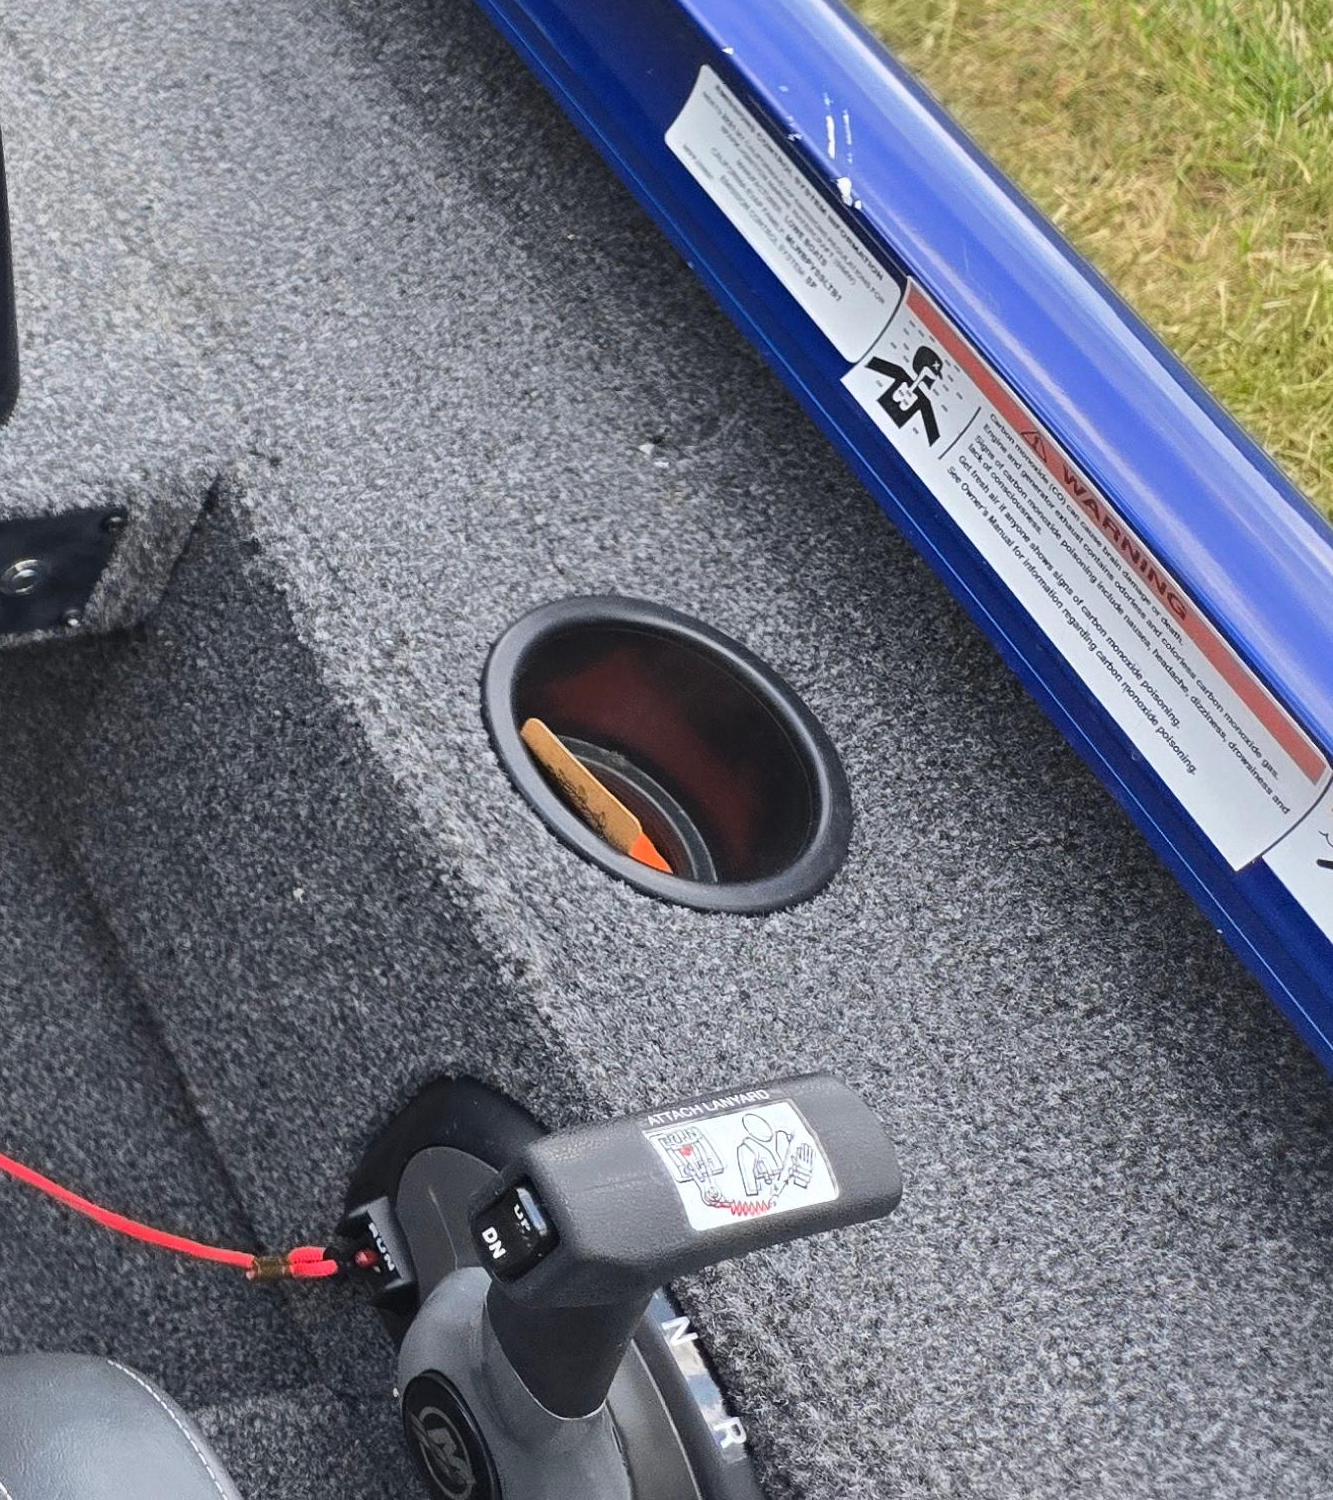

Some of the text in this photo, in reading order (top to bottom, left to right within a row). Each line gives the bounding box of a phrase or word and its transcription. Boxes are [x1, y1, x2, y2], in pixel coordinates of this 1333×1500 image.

[967, 443, 1042, 535] lack of consciousness.
[990, 413, 1015, 445] Carbon
[1048, 483, 1067, 505] (CO)
[1066, 504, 1080, 522] can
[1080, 521, 1102, 548] cause
[1101, 546, 1122, 571] brain
[1122, 570, 1152, 605] damage
[1151, 605, 1161, 617] or
[1160, 616, 1183, 646] death.
[1062, 464, 1187, 621] WARNING
[947, 466, 962, 484] See
[987, 515, 1015, 547] Manual
[1012, 545, 1026, 560] for
[1022, 558, 1064, 609] information
[1061, 608, 1098, 652] regarding
[1095, 650, 1123, 683] carbon
[1121, 681, 1159, 726] monoxide
[1155, 726, 1197, 775] poisoning.
[958, 455, 1181, 729] Get fresh air if anyone shows signs of carbon monoxide poisoning.
[975, 435, 1291, 815] Signs of carbon monoxide poisoning include nausea, headache, dizziness, drowsiness and
[983, 423, 1278, 780] Engine and generator exhaust contains odorless and colorless carbon monoxide gas.
[647, 1089, 770, 1126] ATTACH LANYARD
[482, 1226, 507, 1260] DN
[661, 1316, 699, 1347] N
[712, 1416, 747, 1449] R
